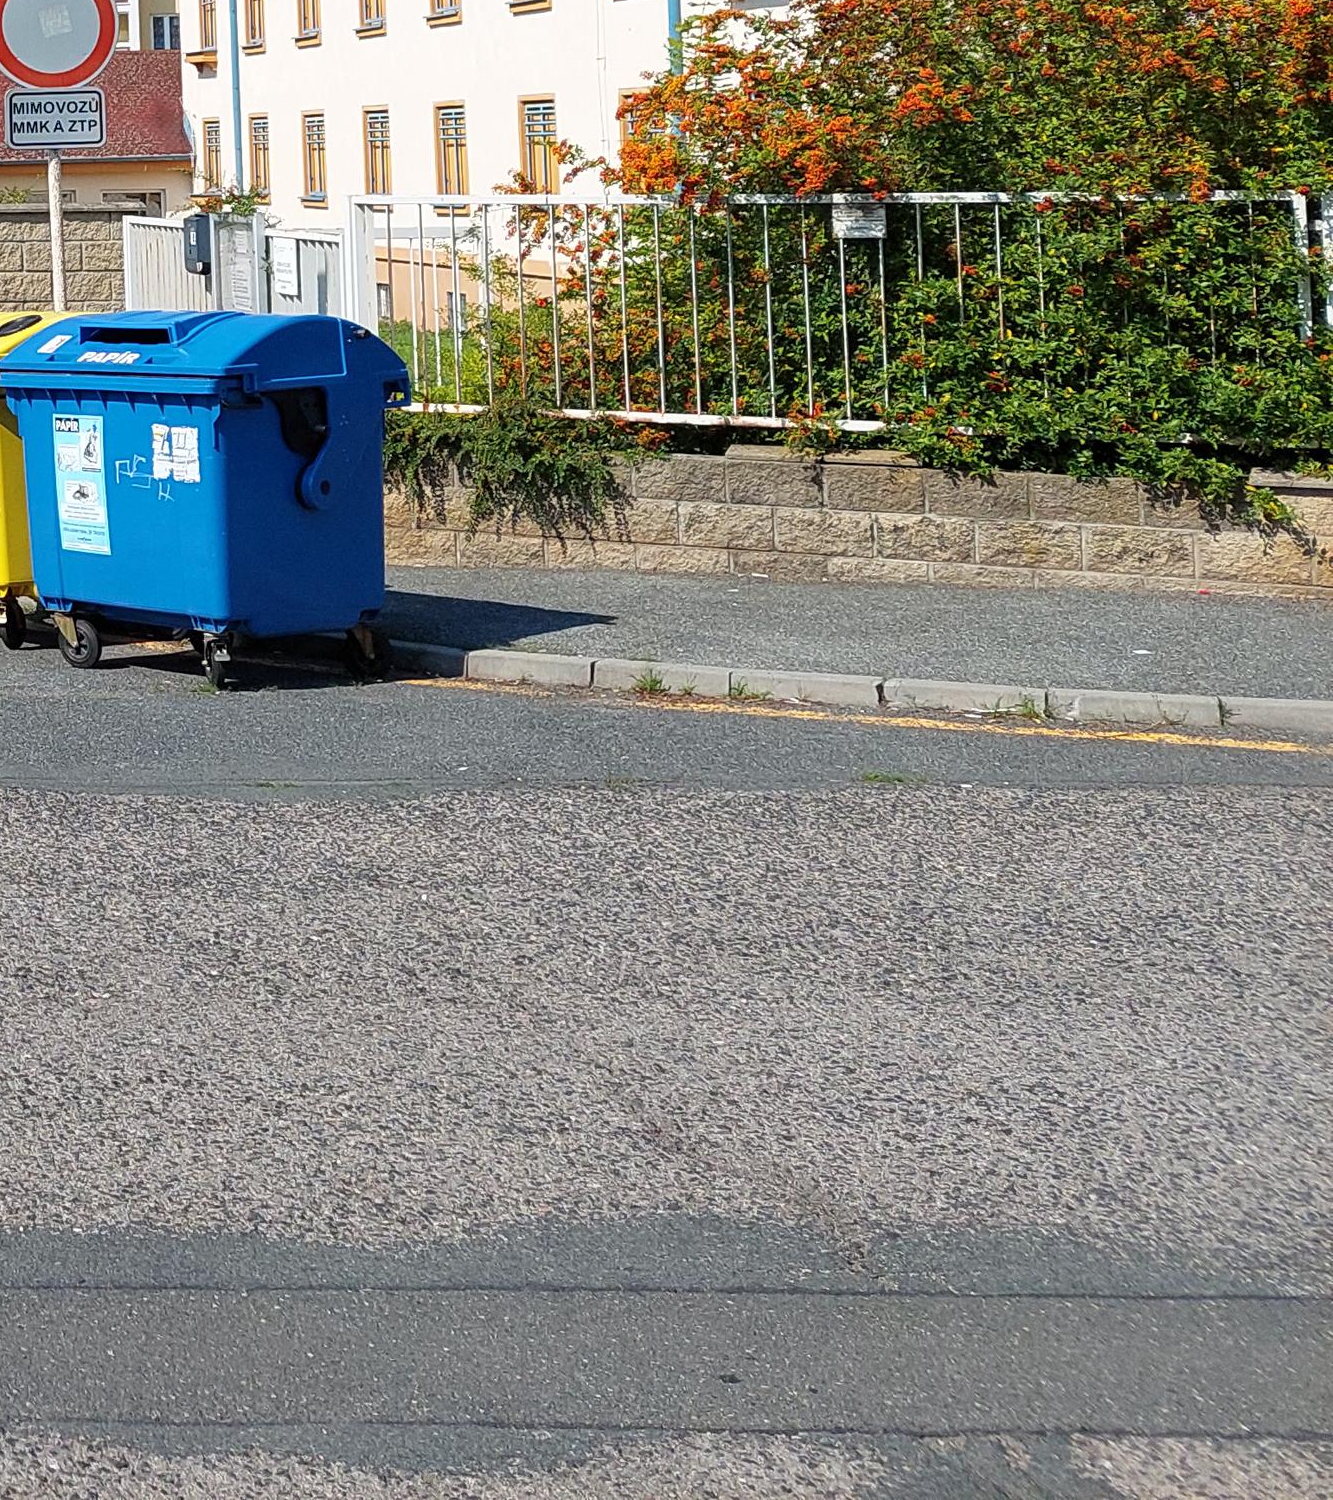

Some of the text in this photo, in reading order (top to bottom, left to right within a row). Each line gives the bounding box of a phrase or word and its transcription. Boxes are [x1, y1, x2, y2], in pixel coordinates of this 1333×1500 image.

[13, 119, 97, 134] MMK A ZTP
[77, 351, 140, 364] PAPÍR
